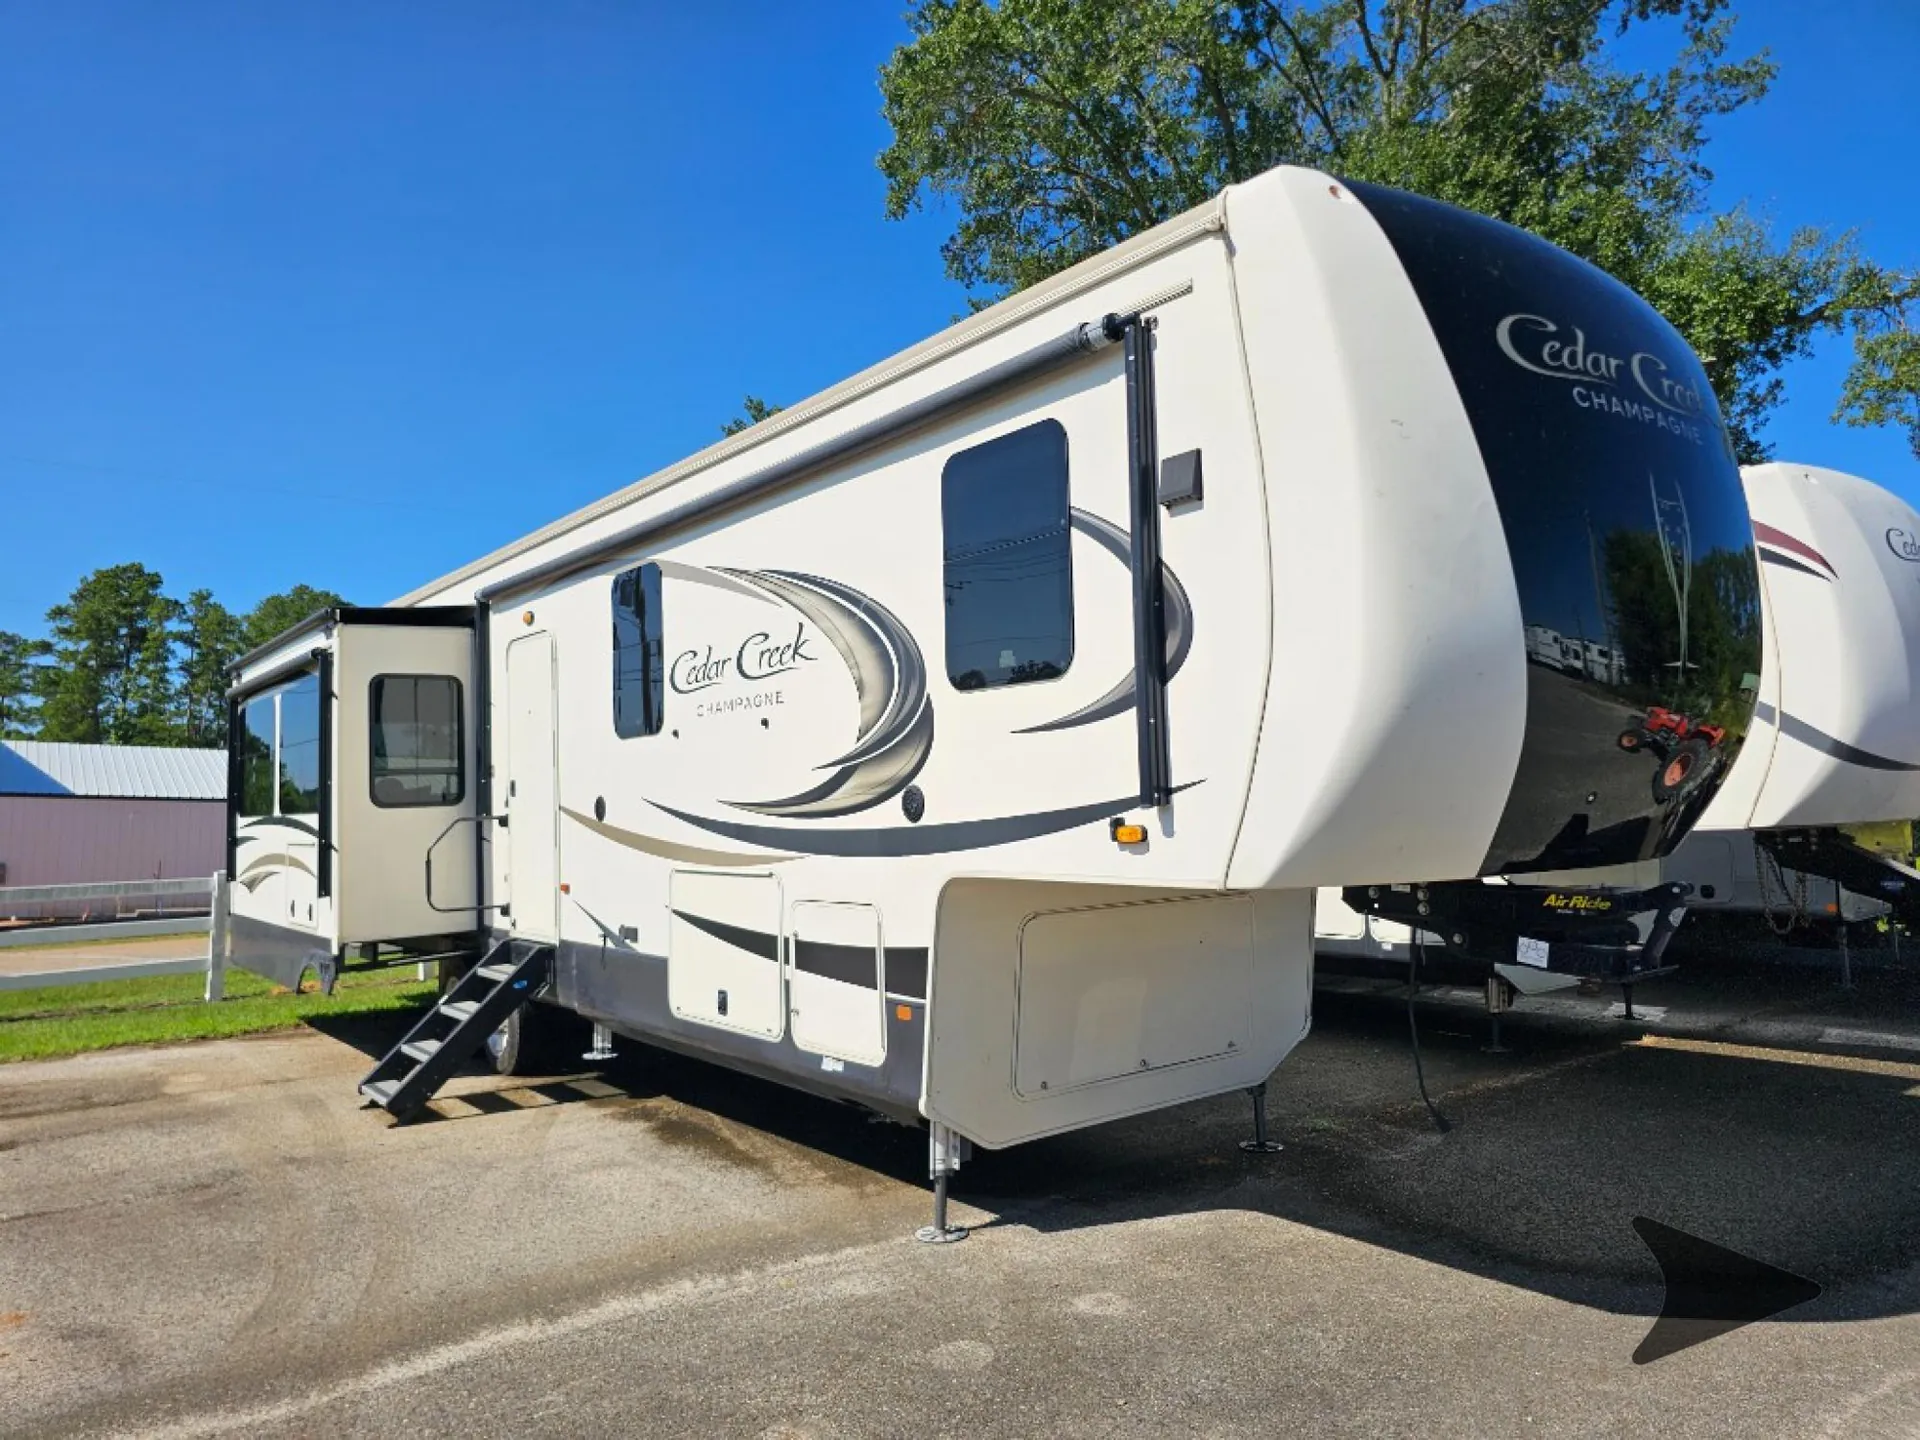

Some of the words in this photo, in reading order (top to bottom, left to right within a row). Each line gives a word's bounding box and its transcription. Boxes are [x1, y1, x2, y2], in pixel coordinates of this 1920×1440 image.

[1496, 312, 1624, 386] Cedar
[1572, 386, 1703, 445] CHAMPAGNE
[669, 645, 732, 694] Cedar
[736, 621, 818, 680] Creek
[696, 691, 785, 717] CHAMPAGNE
